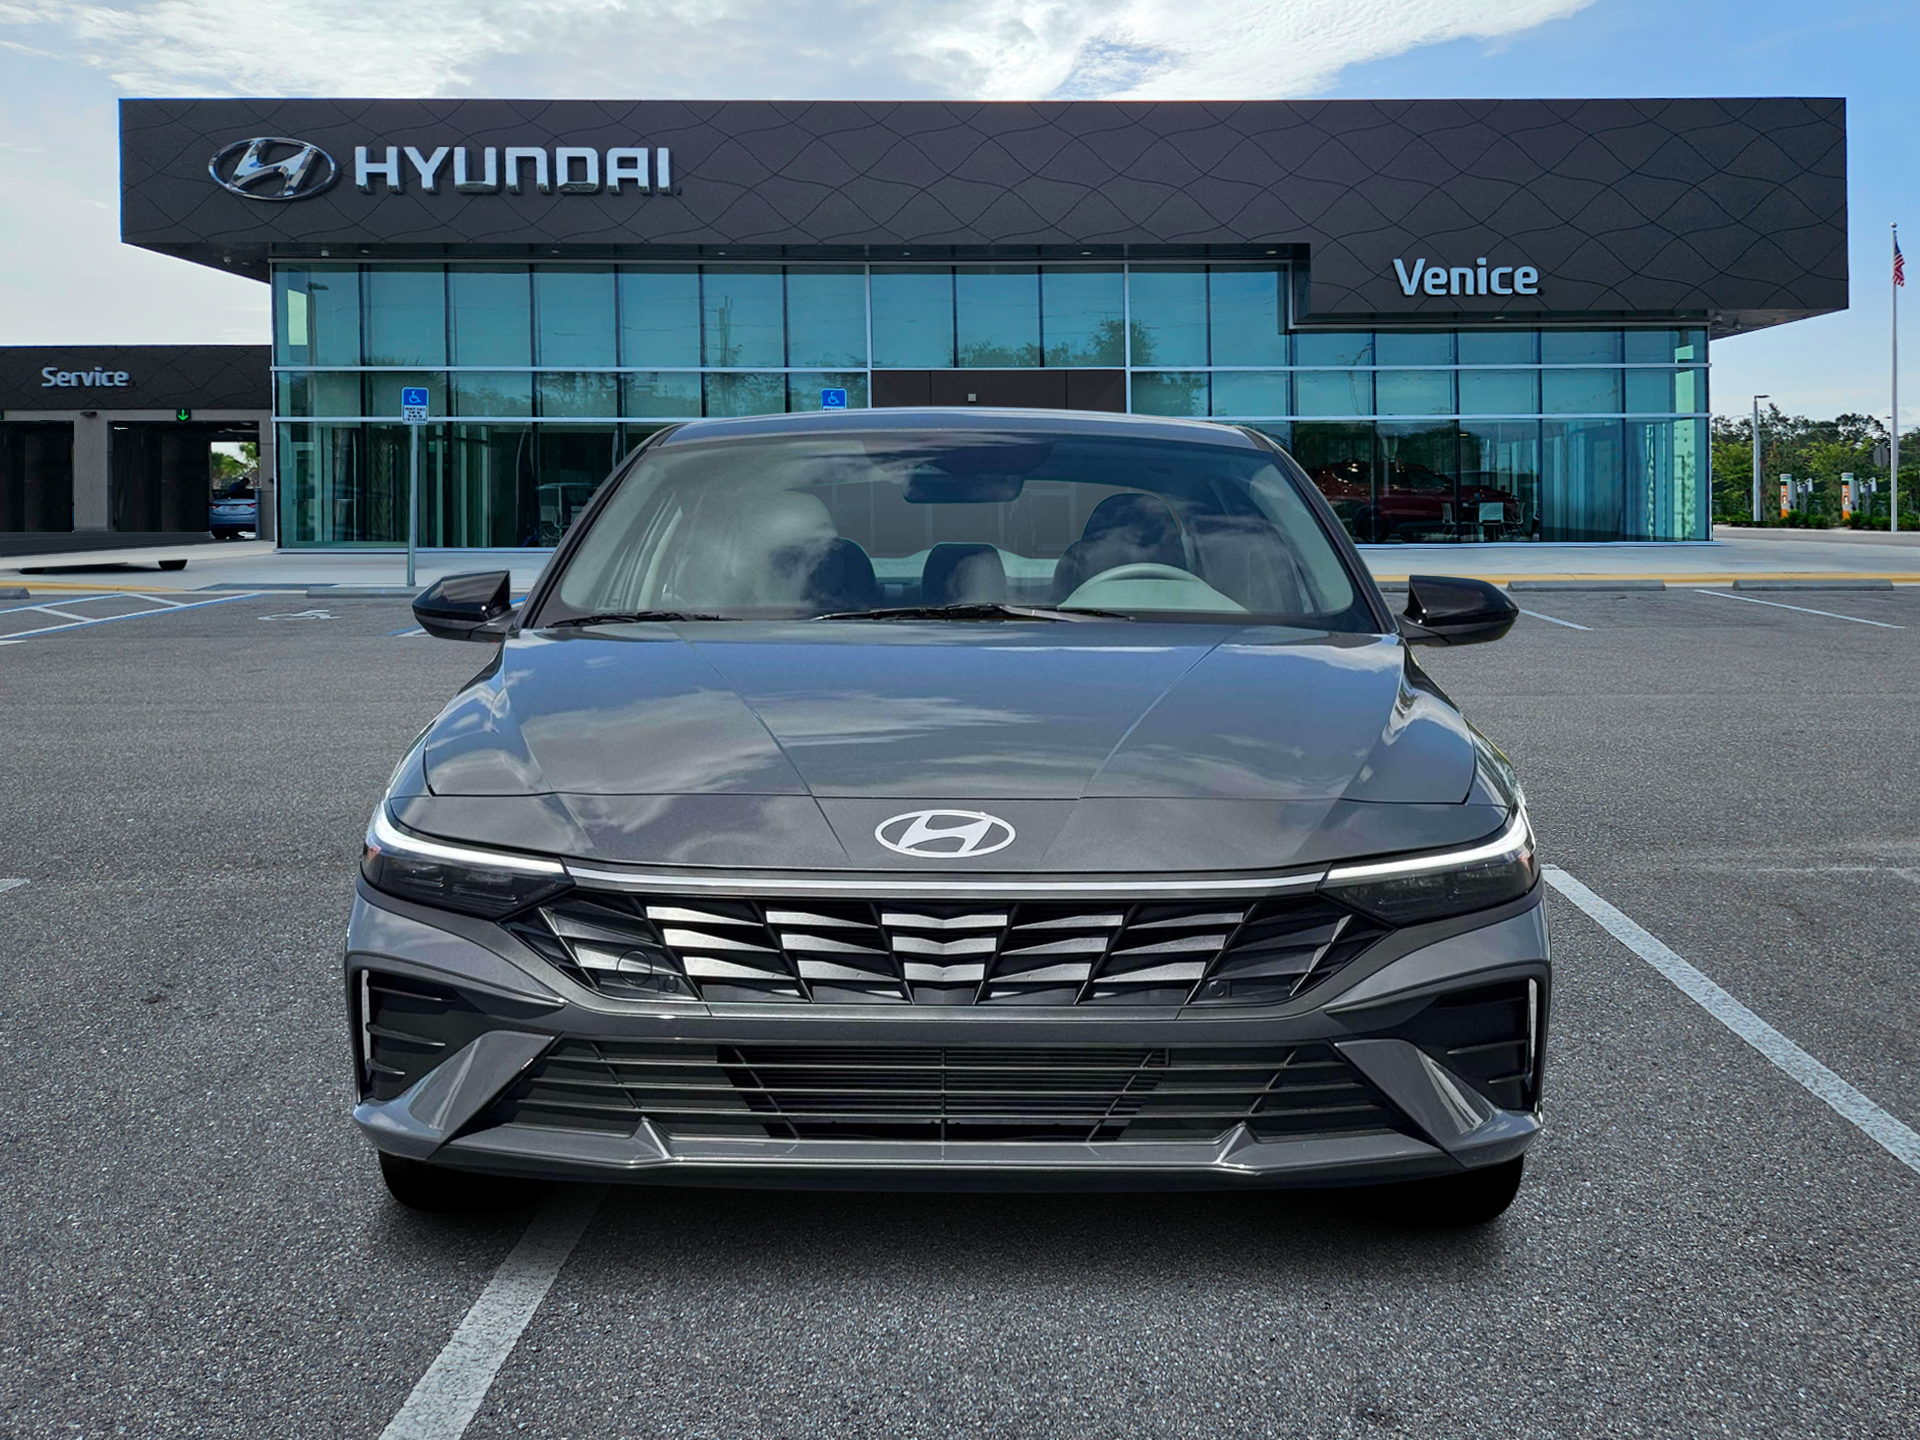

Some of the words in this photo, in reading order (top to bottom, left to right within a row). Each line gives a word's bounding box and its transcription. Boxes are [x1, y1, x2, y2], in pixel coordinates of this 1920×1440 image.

[355, 146, 670, 194] HYUNDAI
[1393, 257, 1539, 296] Venice
[41, 366, 130, 387] Service
